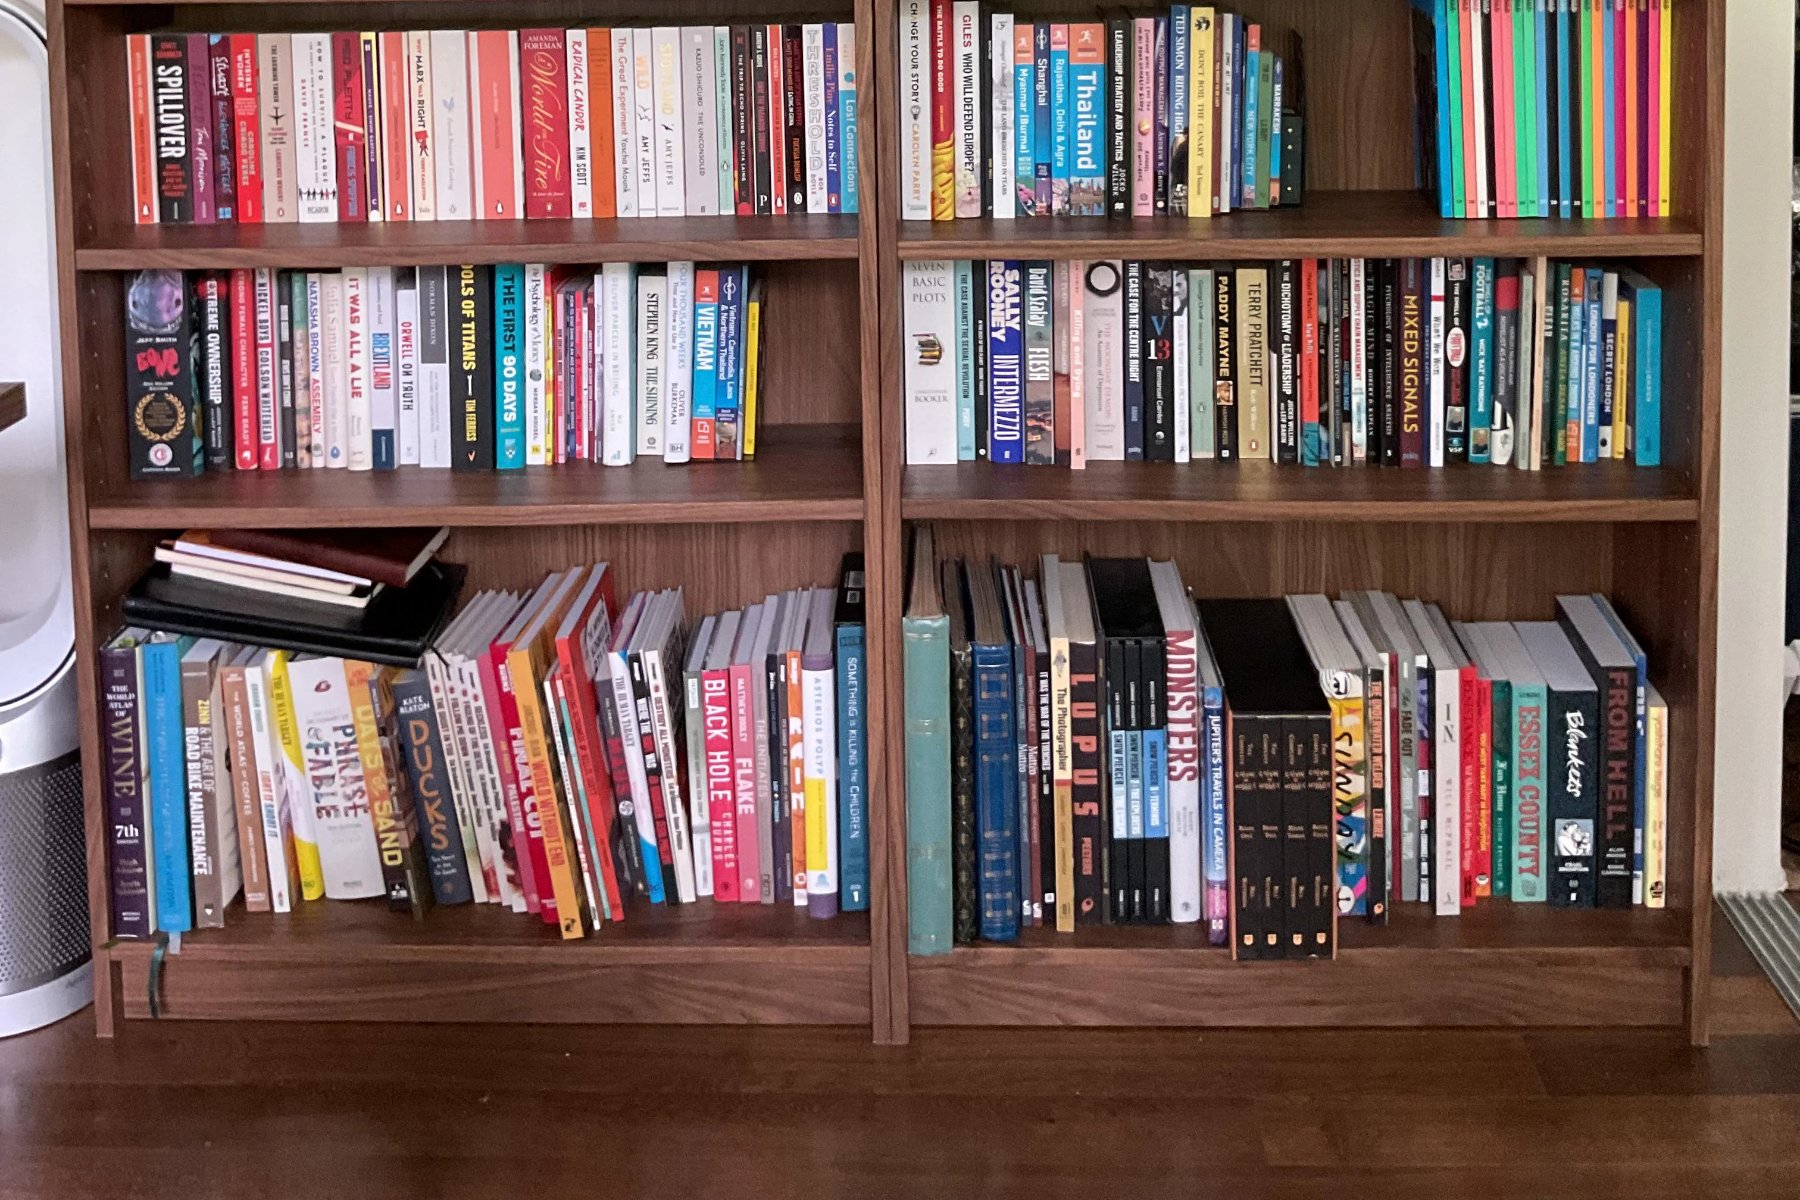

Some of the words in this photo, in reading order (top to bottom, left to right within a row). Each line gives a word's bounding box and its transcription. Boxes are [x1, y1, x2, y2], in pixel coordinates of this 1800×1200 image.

[962, 14, 972, 47] GILES
[1175, 14, 1185, 29] TED
[416, 56, 424, 83] MARX
[572, 40, 583, 85] RADICAL
[1115, 30, 1123, 74] LEADERSHIP
[1174, 31, 1185, 70] SIMON
[1036, 58, 1048, 106] Shanghai
[1056, 59, 1065, 106] Rajasthan,
[1114, 76, 1123, 112] STRATEGY
[157, 64, 186, 158] SPILLOVER
[417, 99, 426, 128] RIGHT
[574, 89, 585, 131] CANDOR
[1056, 109, 1066, 132] Delhi
[1076, 71, 1097, 170] Thailand
[1115, 115, 1123, 130] AND
[576, 147, 585, 160] KIM
[641, 135, 649, 159] AMY
[1054, 145, 1065, 167] Agra
[1115, 132, 1123, 161] TACTICS
[576, 163, 587, 186] SCOTT
[641, 162, 650, 183] JEFFS
[503, 275, 514, 301] THE
[912, 278, 946, 287] BASIC
[912, 294, 946, 302] PLOTS
[1004, 269, 1020, 331] SALLY
[1218, 276, 1230, 321] PADDY
[1248, 283, 1261, 320] TERRY
[462, 300, 474, 318] OF
[504, 306, 515, 352] FIRST
[646, 293, 659, 332] STEPHEN
[1404, 295, 1418, 354] MIXED
[1432, 316, 1442, 342] What
[462, 322, 476, 370] TITANS
[647, 335, 658, 360] KING
[697, 307, 714, 370] VIETNAM
[1219, 327, 1230, 377] MAYNE
[1249, 324, 1263, 386] PRATCHETT
[1432, 344, 1440, 356] We
[504, 355, 516, 378] 90
[1432, 359, 1440, 376] Won
[504, 381, 516, 422] DAYS
[1403, 362, 1418, 434] SIGNALS
[108, 701, 133, 709] ATLAS
[704, 678, 727, 740] BLACK
[1056, 688, 1067, 702] The
[1166, 630, 1198, 782] MONSTERS
[1608, 671, 1629, 751] FROM
[111, 716, 136, 798] WINE
[1056, 706, 1067, 772] Photographer
[1071, 673, 1098, 817] LUPUS
[1208, 715, 1221, 765] JUPITER'S
[1518, 706, 1541, 778] ESSEX
[1564, 710, 1585, 798] Blankets
[409, 719, 449, 850] DUCKS
[509, 726, 534, 792] FINAL
[523, 793, 542, 839] CUT
[708, 751, 732, 802] HOLE
[735, 757, 755, 816] FLAKE
[1211, 768, 1223, 813] TRAVELS
[1606, 761, 1628, 839] HELL
[115, 825, 139, 838] 7th
[722, 812, 735, 869] CHARLES
[1213, 818, 1223, 829] IN
[1518, 784, 1541, 877] COUNTY
[1212, 831, 1224, 872] CAMERA
